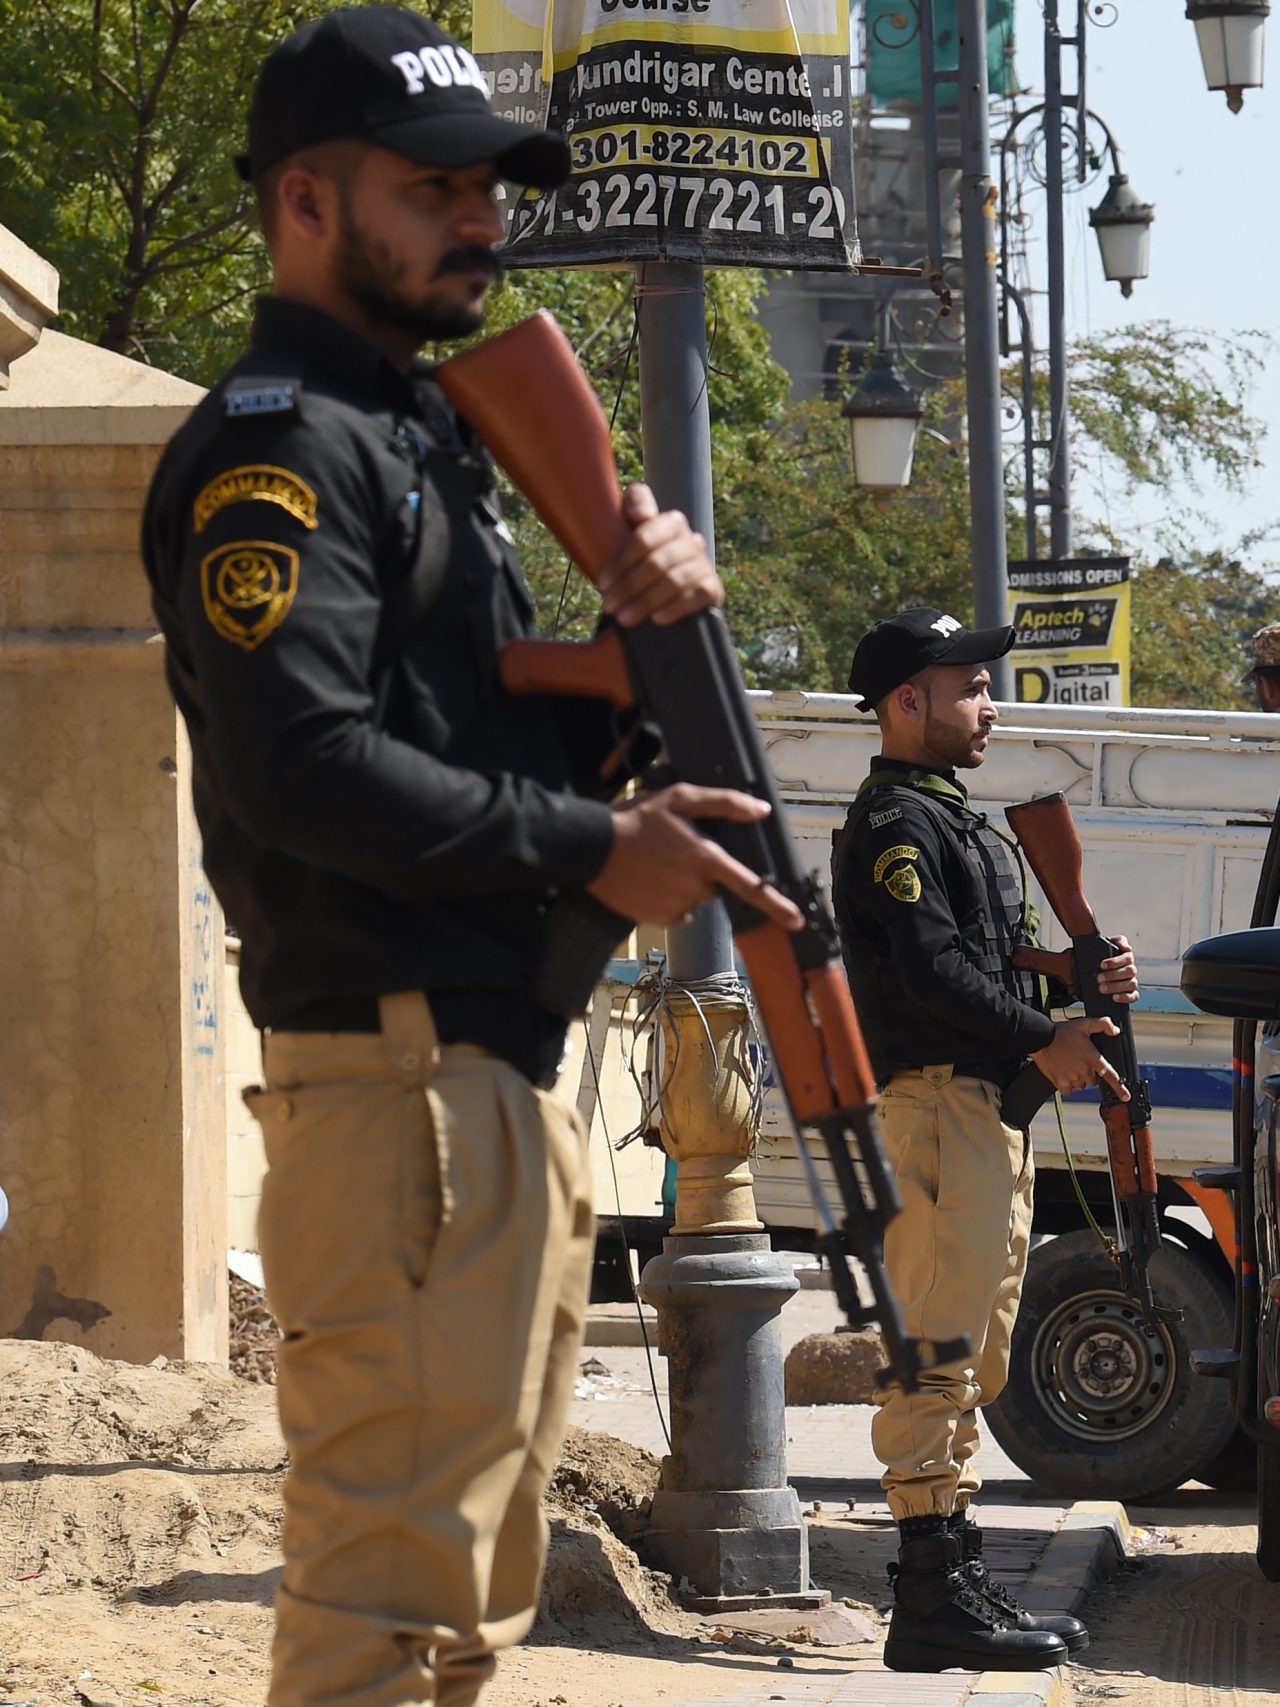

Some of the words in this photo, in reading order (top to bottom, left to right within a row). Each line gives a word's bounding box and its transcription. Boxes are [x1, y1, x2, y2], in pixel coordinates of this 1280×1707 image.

[726, 56, 812, 98] Cente
[584, 97, 638, 121] Tower
[687, 100, 703, 118] S.
[708, 101, 729, 119] M.
[733, 102, 764, 125] Law
[768, 107, 821, 133] Colleg
[569, 130, 808, 174] 301-8224102
[1009, 570, 1082, 587] DMISSIONS
[1085, 568, 1122, 584] OPEN
[1016, 627, 1082, 644] LEARNING
[1019, 607, 1085, 631] Aptech
[1014, 667, 1110, 704] Digital
[869, 807, 904, 829] POLICE
[875, 846, 917, 881] COMMANDO
